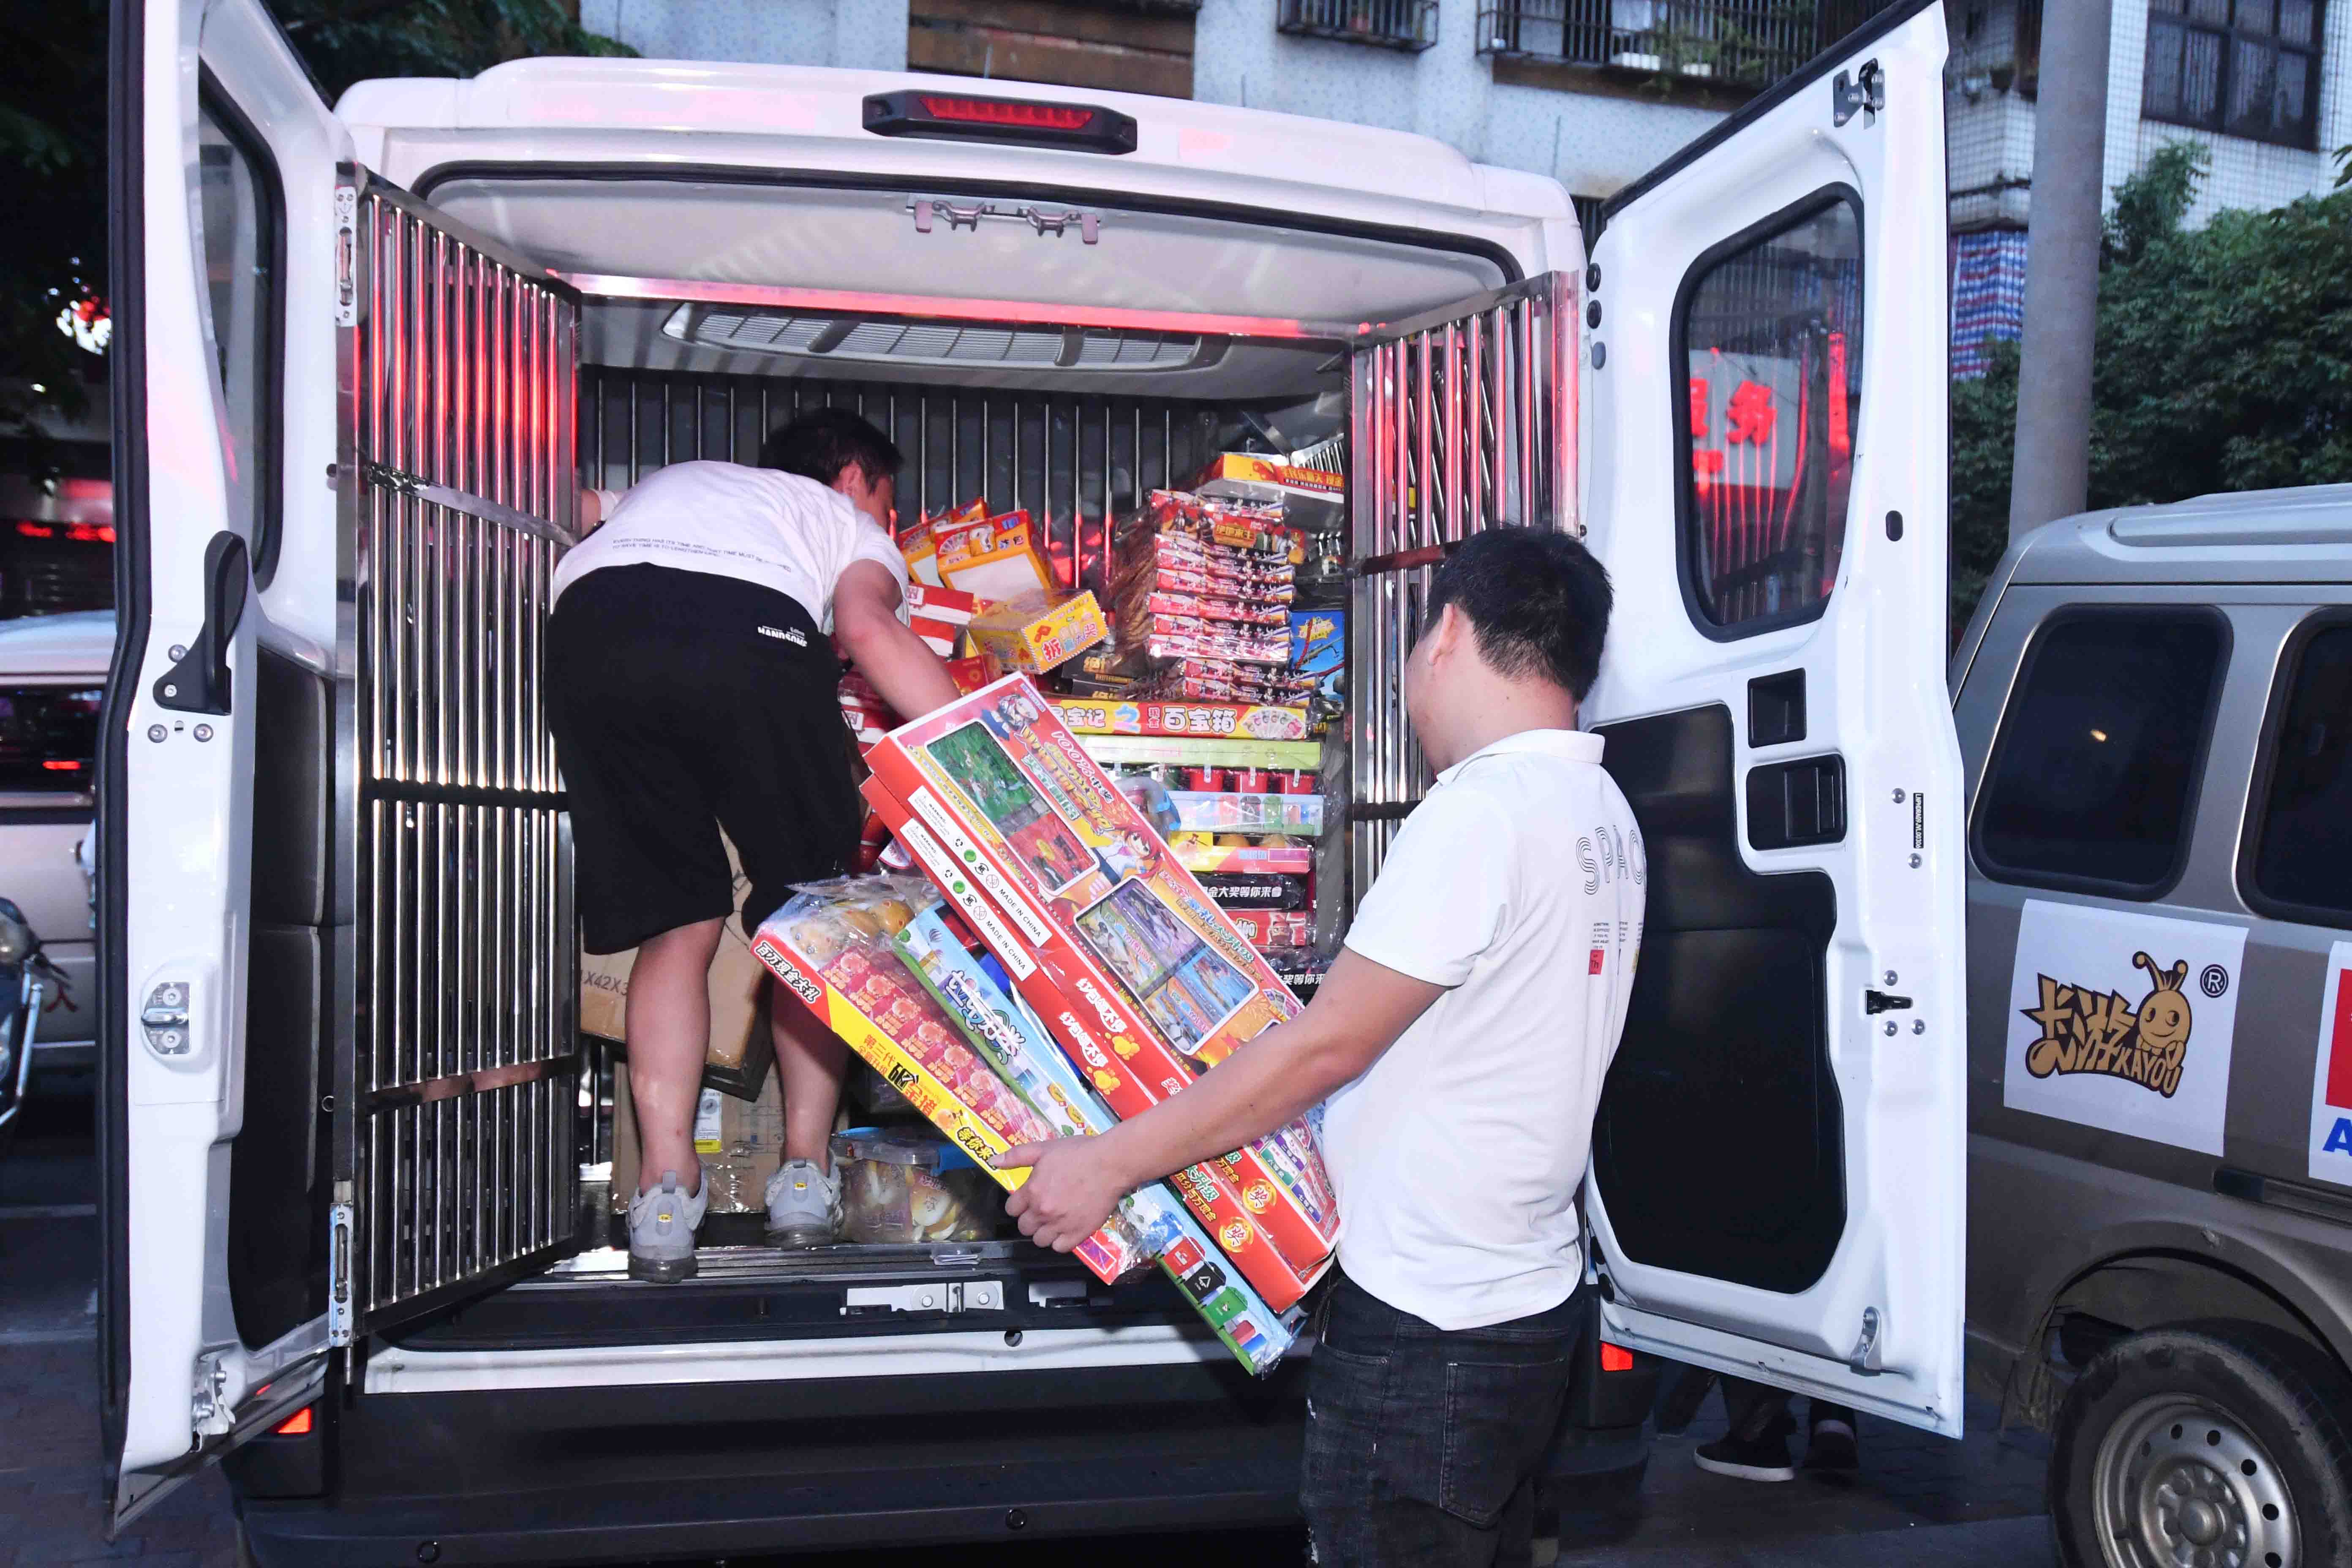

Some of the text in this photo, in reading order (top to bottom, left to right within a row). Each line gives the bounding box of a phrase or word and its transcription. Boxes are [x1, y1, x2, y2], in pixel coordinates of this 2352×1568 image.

[1162, 705, 1238, 733] 百宝箱
[998, 889, 1042, 938] MADE IN CHINA
[986, 921, 1026, 970] MADE IN CHINA
[755, 942, 821, 1002] 百万现金大礼
[864, 1034, 896, 1066] 第三代
[2117, 1039, 2183, 1098] KAYOU
